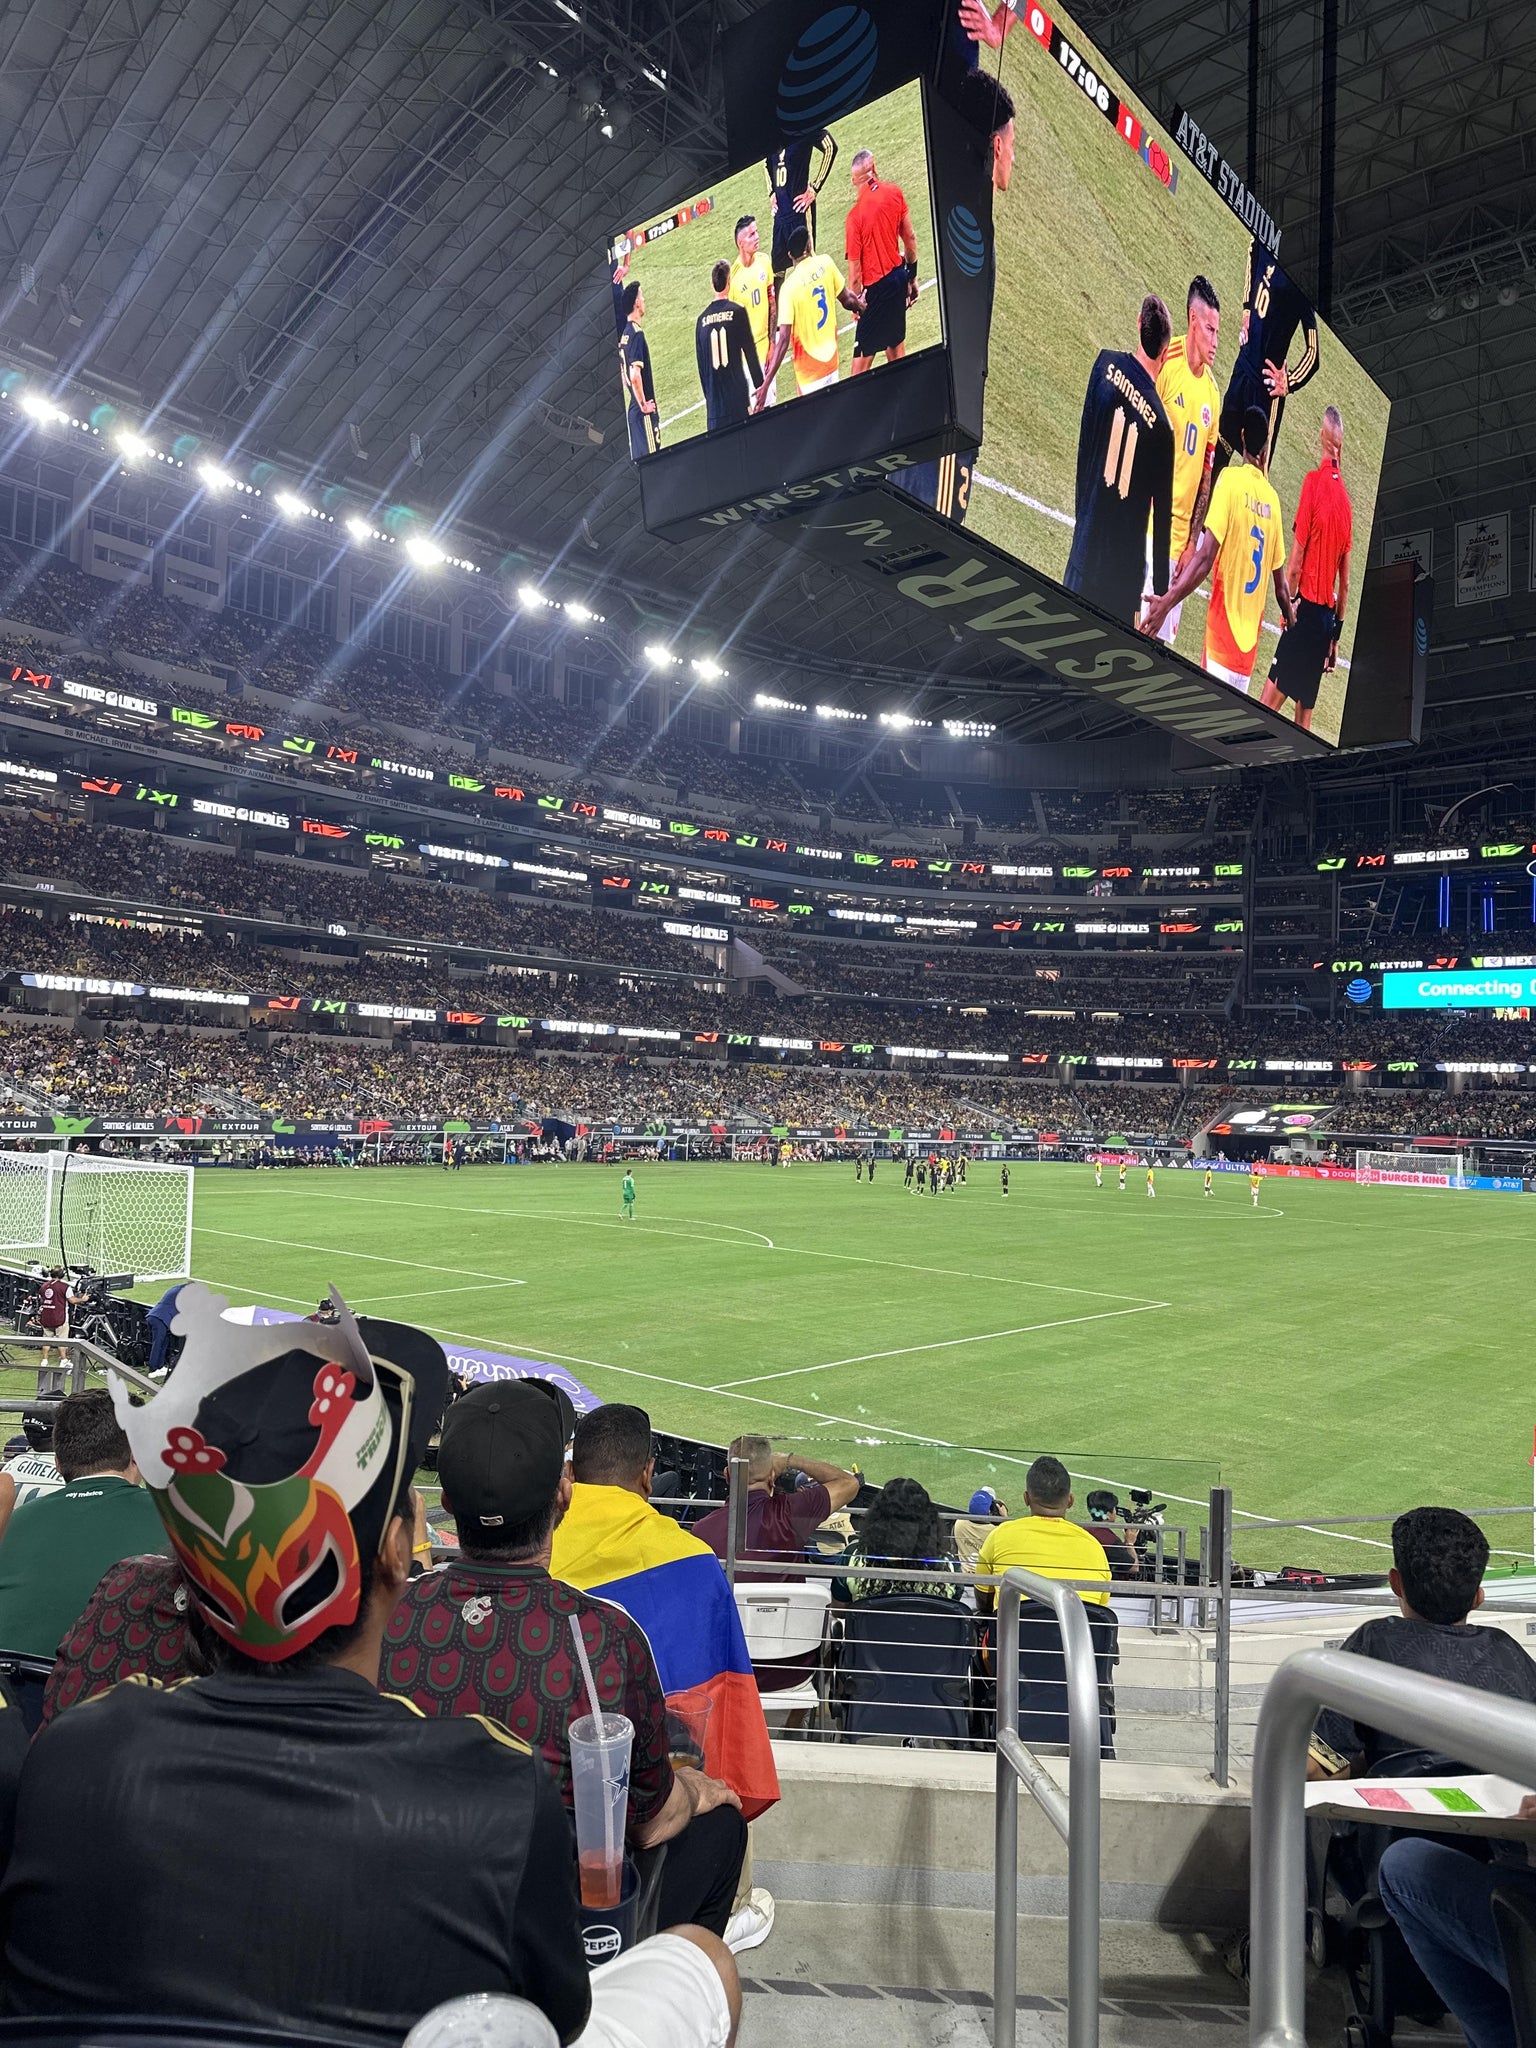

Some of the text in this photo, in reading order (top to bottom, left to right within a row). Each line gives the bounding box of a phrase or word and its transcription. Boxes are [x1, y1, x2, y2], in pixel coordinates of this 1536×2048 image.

[1060, 40, 1110, 112] 17:06
[1124, 116, 1133, 138] 1
[1175, 110, 1282, 260] AT&T STADIUM
[812, 285, 828, 330] 3
[699, 453, 917, 527] WINSTAR
[1244, 525, 1265, 594] 3
[897, 558, 1264, 739] WINSTAR
[75, 731, 110, 746] MICHAEL
[111, 739, 132, 750] IRVIN
[371, 757, 434, 781] MEXTOUR
[428, 844, 502, 868] VISIT US AT
[796, 846, 843, 860] MEXTOUR
[1142, 866, 1201, 877] MEXTOUR
[1370, 960, 1423, 971] MEXTOUR
[34, 973, 135, 997] VISIT US AT
[1418, 979, 1522, 999] Connecting
[1225, 1163, 1251, 1172] ULTRA
[1382, 1172, 1447, 1185] BURGER KING
[1503, 1181, 1520, 1189] AT&T
[829, 1519, 846, 1530] AT&T
